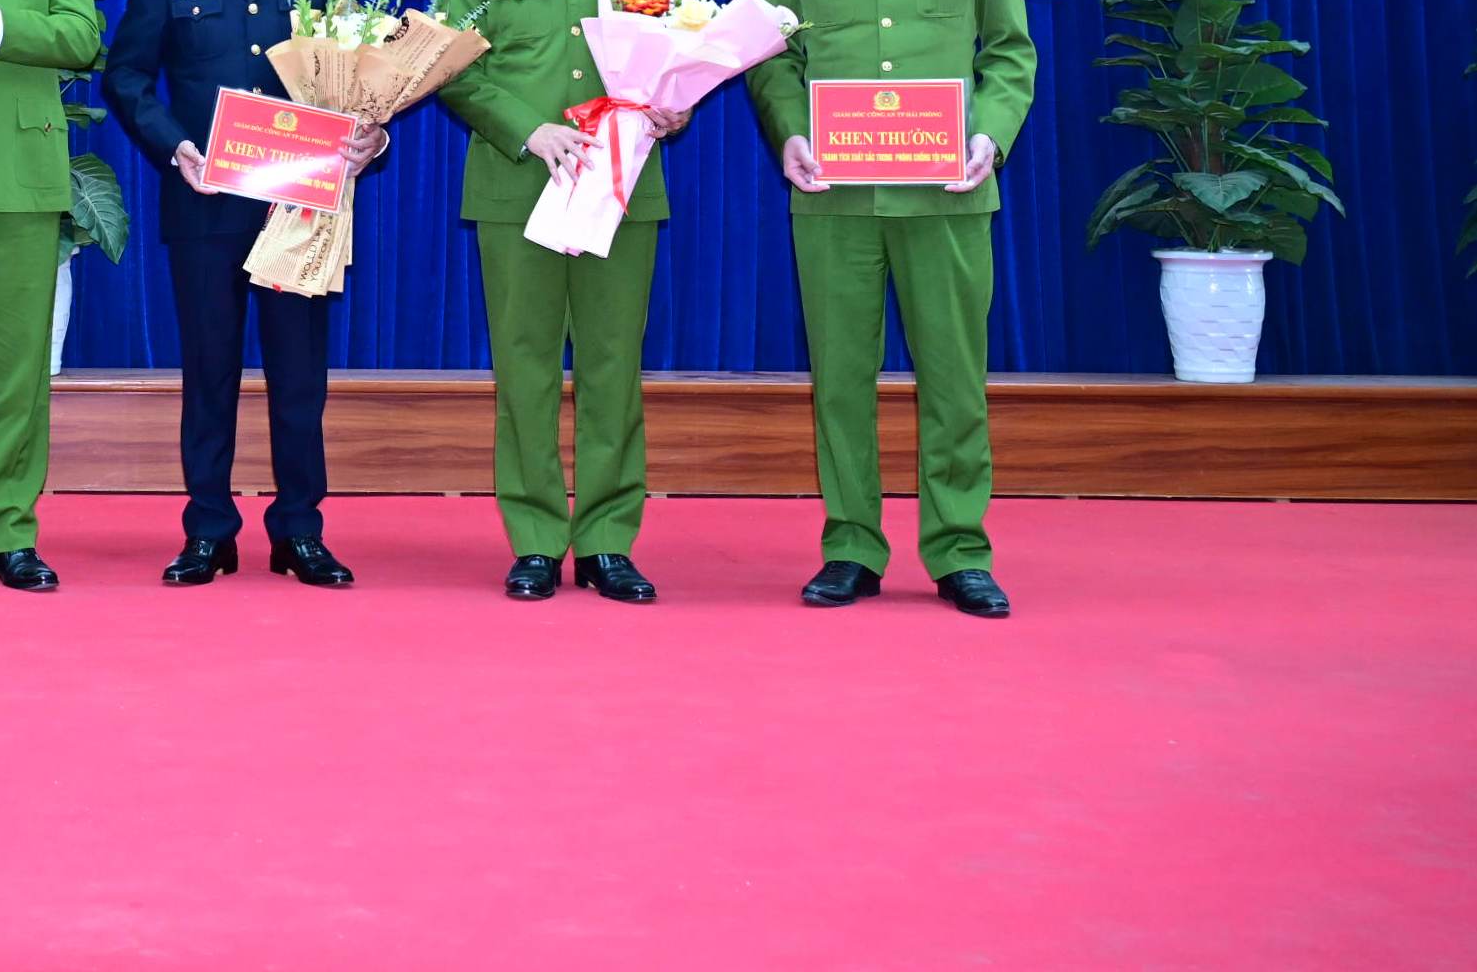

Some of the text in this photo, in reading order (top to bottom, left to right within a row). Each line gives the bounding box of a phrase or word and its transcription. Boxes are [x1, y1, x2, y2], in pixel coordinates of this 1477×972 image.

[829, 128, 948, 145] KHEN THƯỞNG
[224, 140, 266, 158] KHEN
